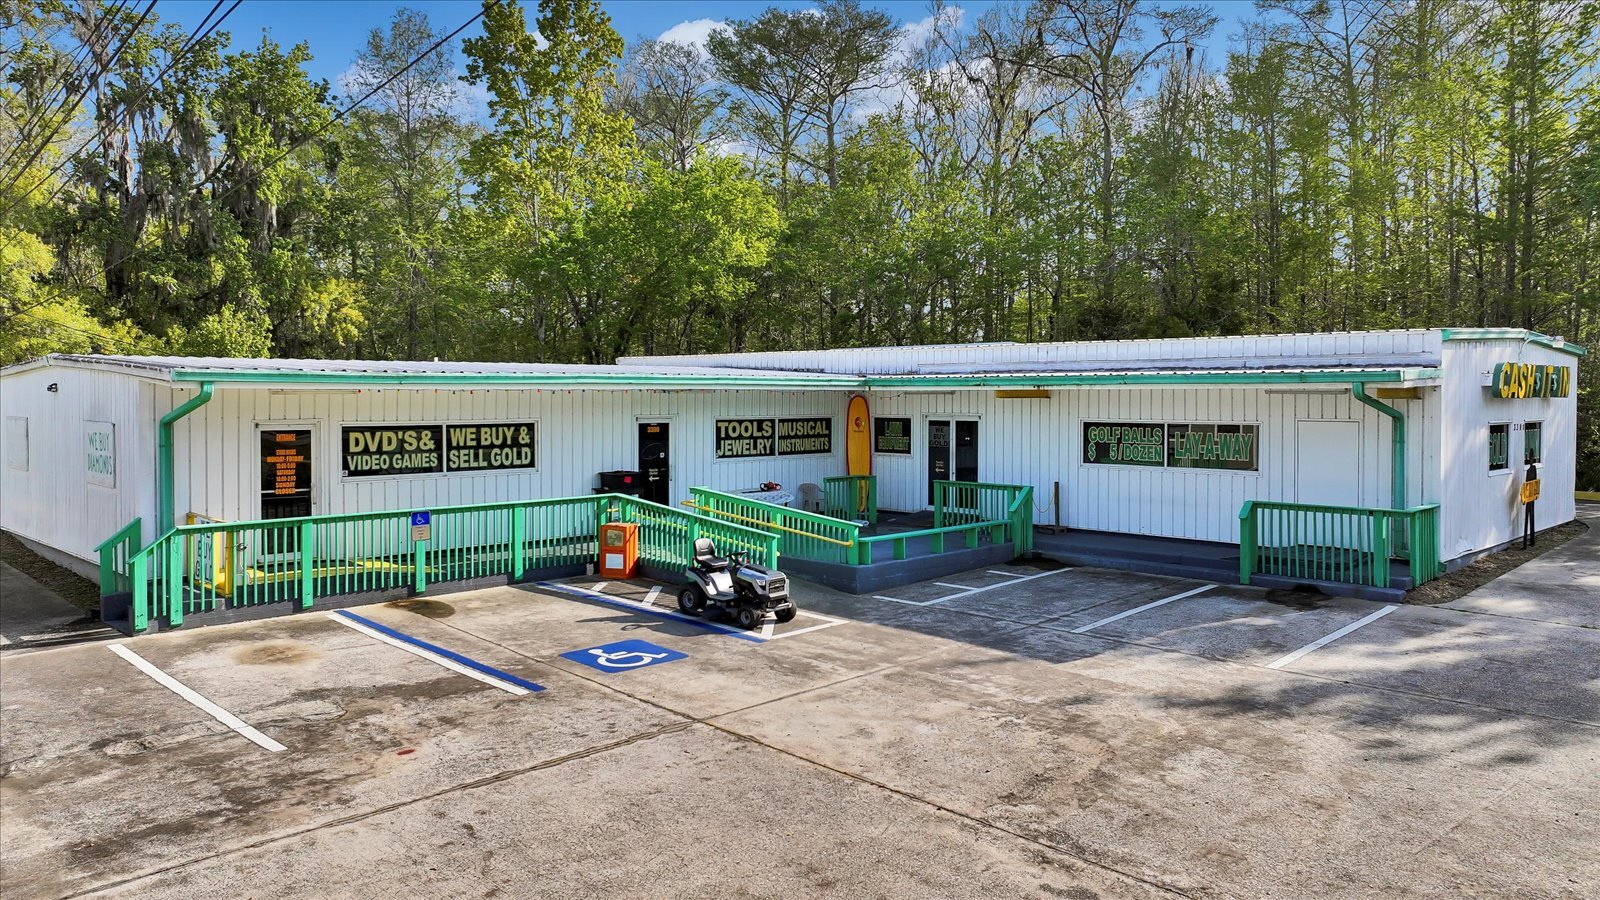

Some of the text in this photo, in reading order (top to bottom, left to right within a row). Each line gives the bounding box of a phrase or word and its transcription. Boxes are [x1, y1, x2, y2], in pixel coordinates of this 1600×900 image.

[1501, 361, 1536, 399] CASH
[1559, 366, 1570, 398] IN
[450, 426, 531, 447] WE BUY &
[717, 421, 772, 438] TOOLS
[778, 420, 829, 437] MUSICAL
[1088, 427, 1162, 444] GOLF BALLS
[88, 432, 98, 451] WE
[717, 438, 772, 456] JEWELRY
[778, 437, 829, 452] INSTRUMENTS
[1174, 431, 1253, 461] LAY-A-WAY
[449, 447, 531, 468] SELL GOLD
[1088, 443, 1096, 461] $
[347, 452, 438, 471] VIDEO GAMES
